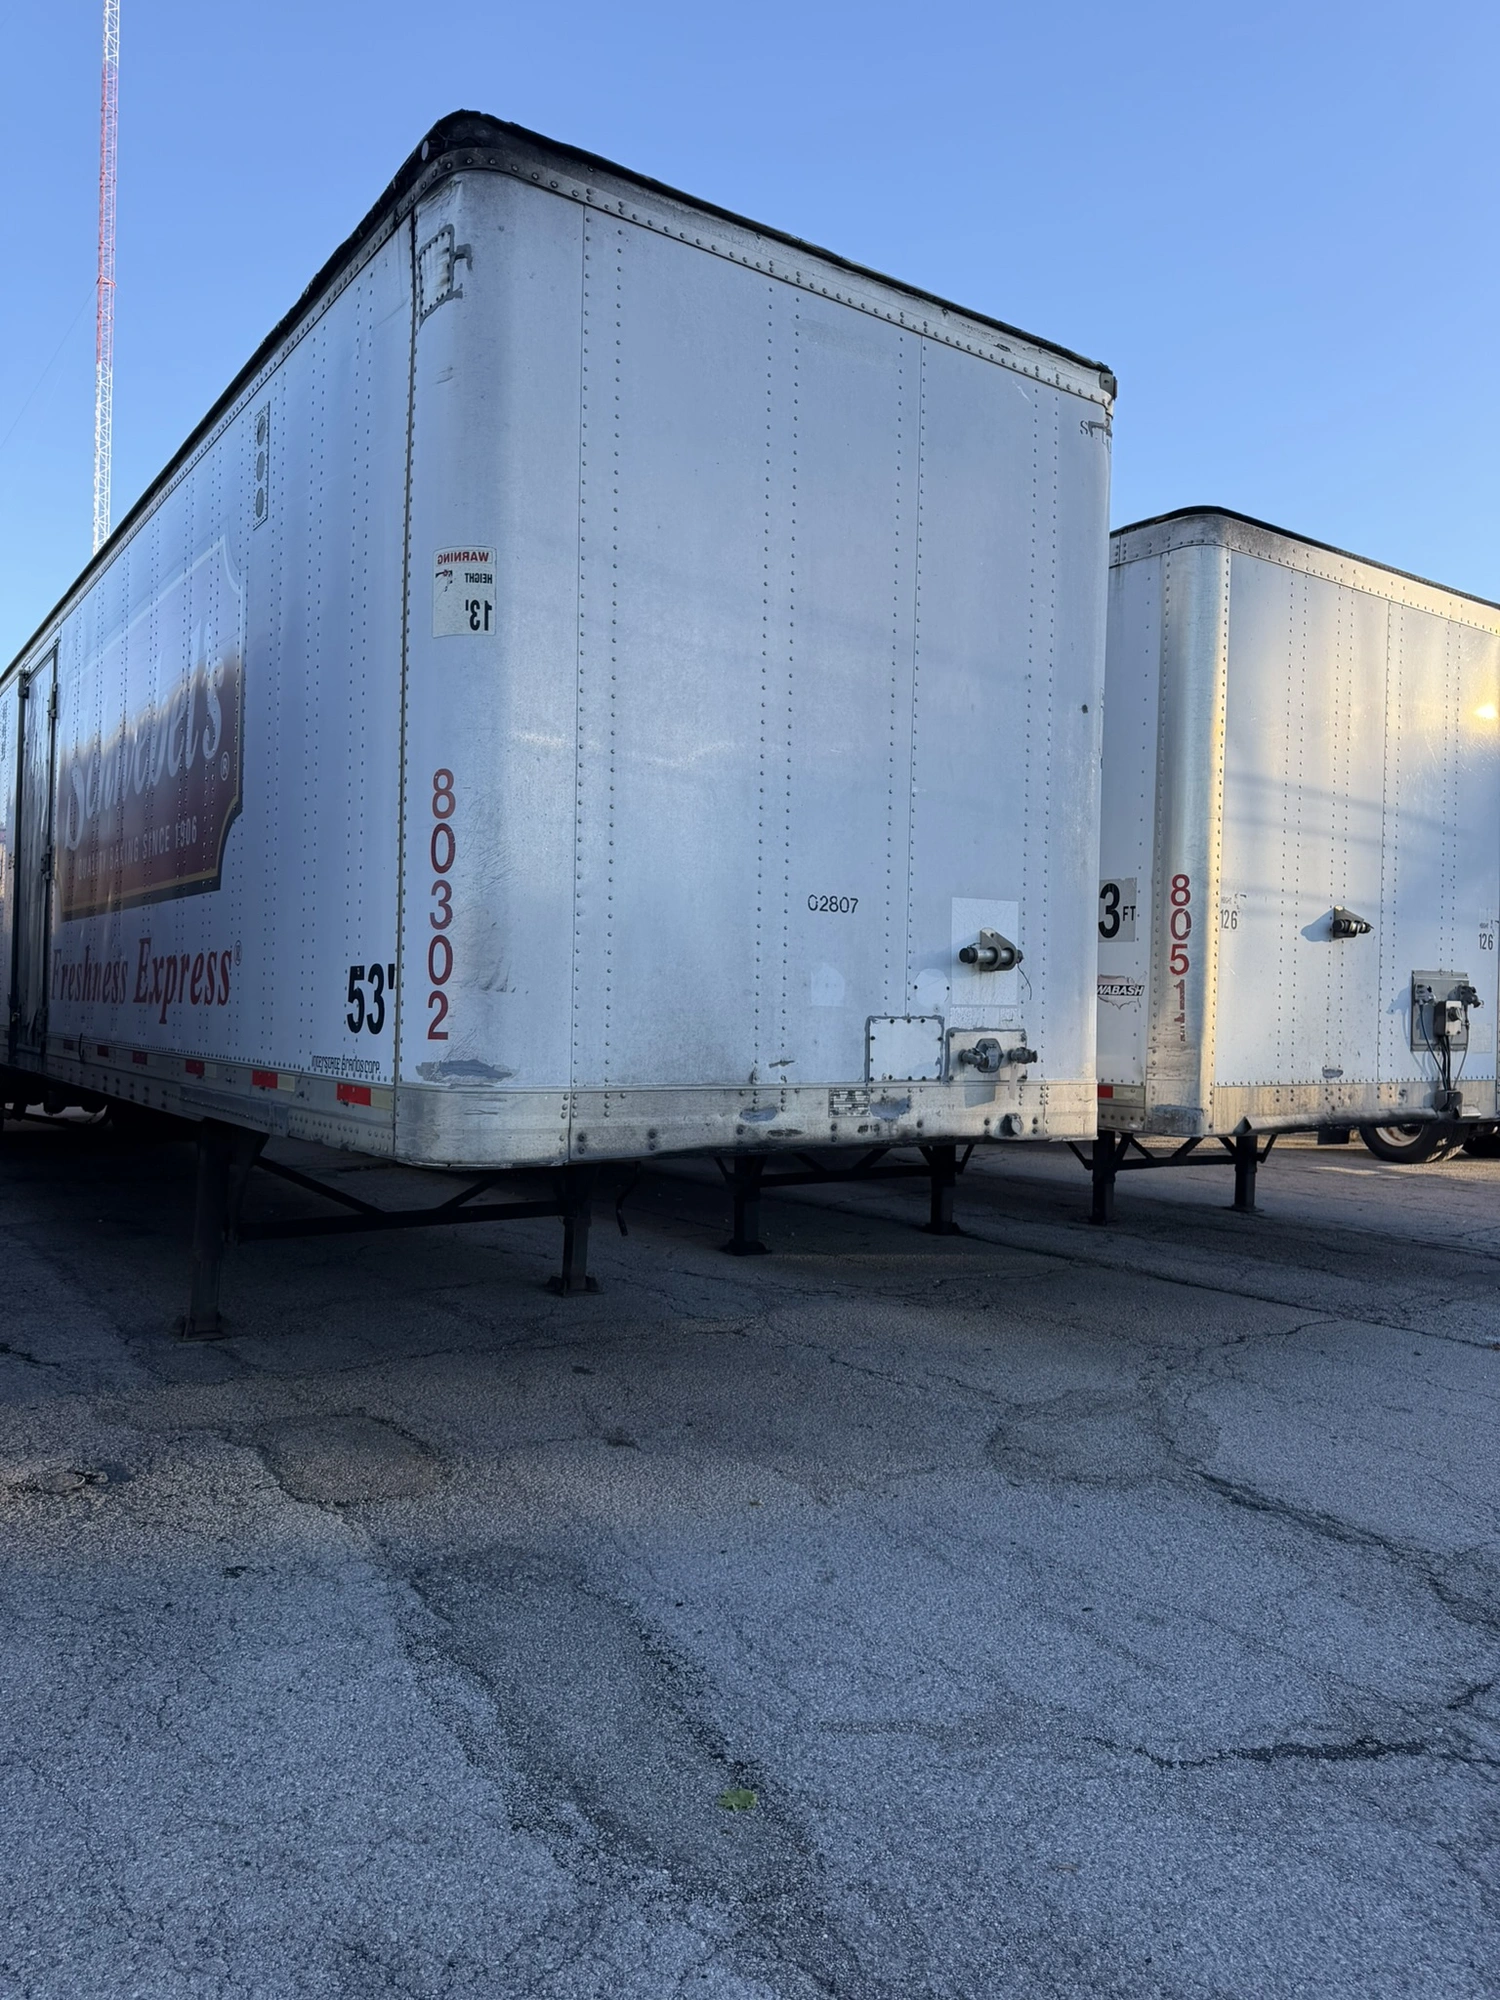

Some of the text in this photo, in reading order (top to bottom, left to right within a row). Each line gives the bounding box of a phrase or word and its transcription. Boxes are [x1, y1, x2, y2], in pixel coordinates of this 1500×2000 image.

[142, 825, 171, 859] SINCE
[174, 815, 198, 849] 1906
[427, 768, 457, 1041] 80302
[1122, 905, 1136, 921] FT
[51, 937, 232, 1025] Freshness Express
[1097, 985, 1144, 996] WABASH
